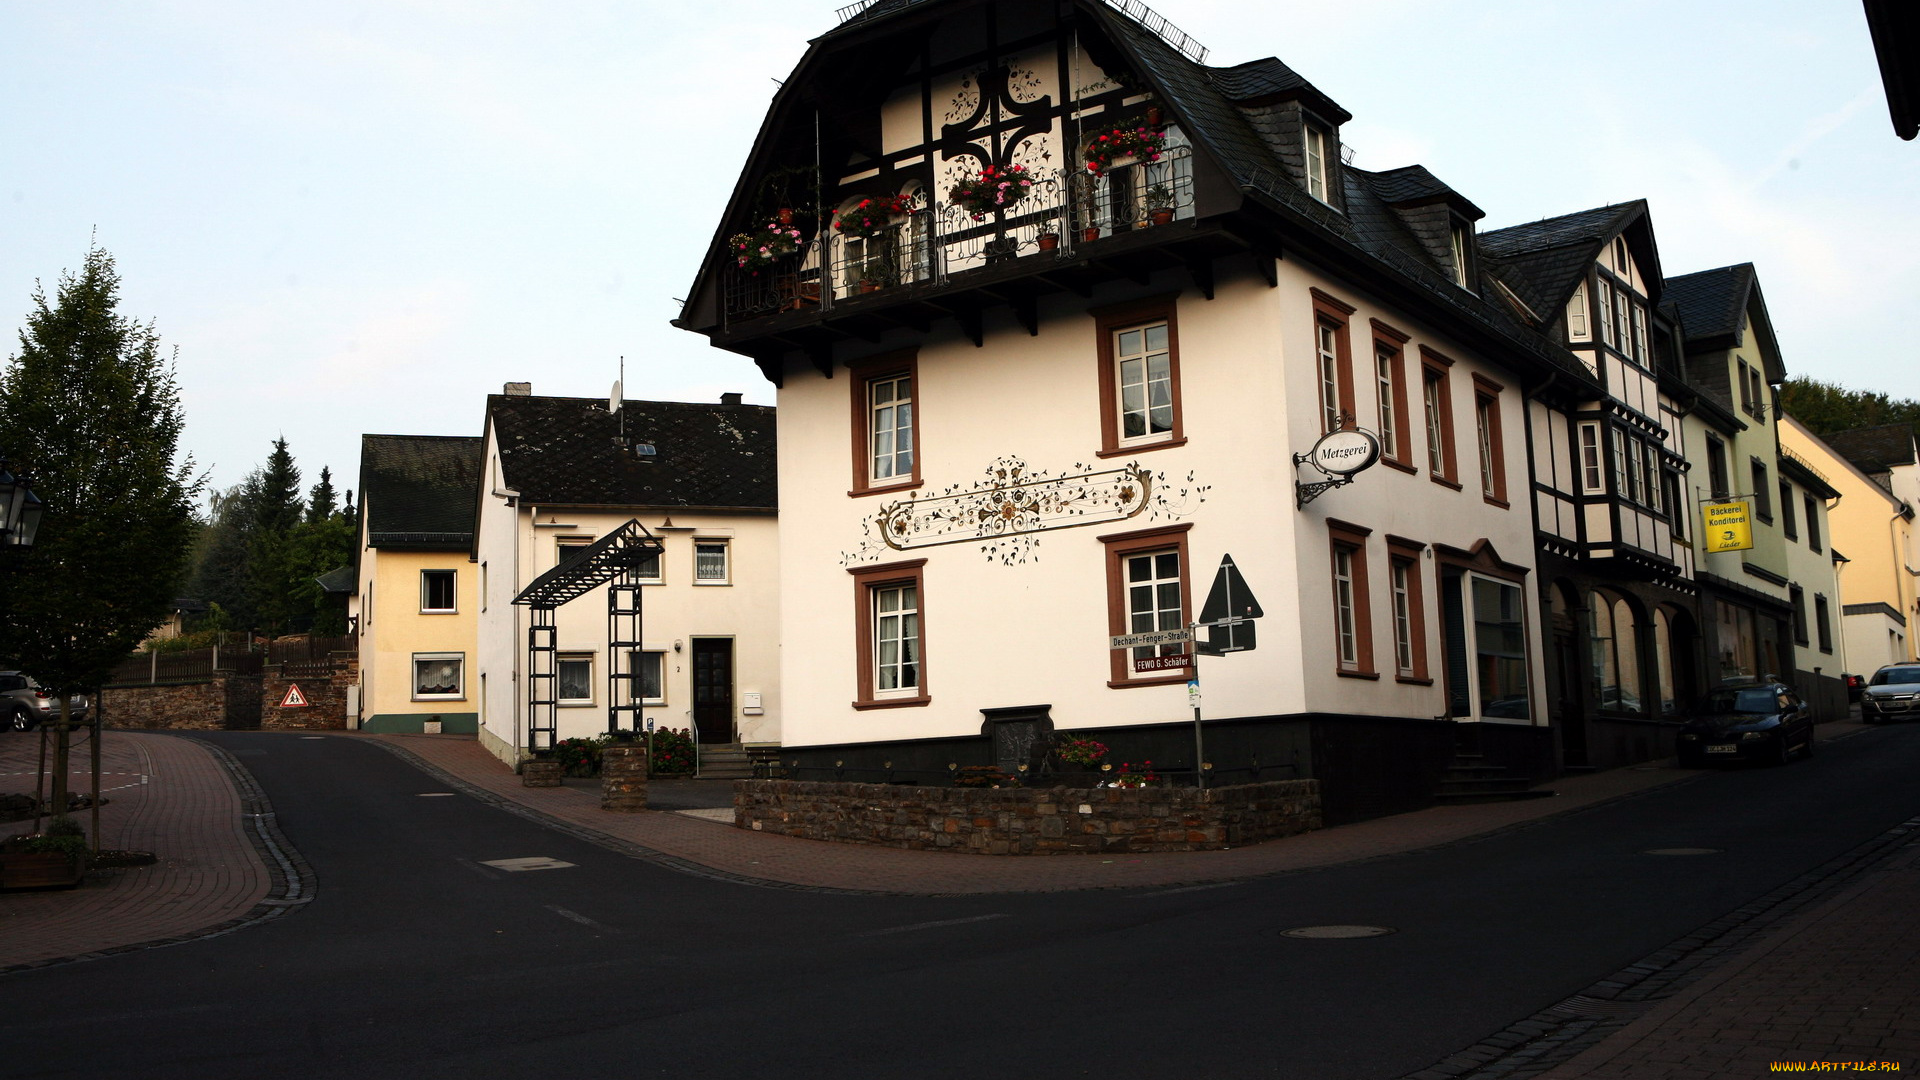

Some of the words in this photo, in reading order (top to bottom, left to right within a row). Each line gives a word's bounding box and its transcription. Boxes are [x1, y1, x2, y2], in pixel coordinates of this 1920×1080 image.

[1320, 442, 1368, 461] Metzgerei
[1710, 505, 1742, 516] Bäckerei
[1708, 516, 1746, 527] Konditorei
[1113, 631, 1189, 647] Dechant-Fenger-Straße
[676, 665, 681, 673] 2
[1137, 660, 1155, 670] FEWO
[1156, 659, 1163, 668] G.
[1164, 657, 1189, 668] Schäfer
